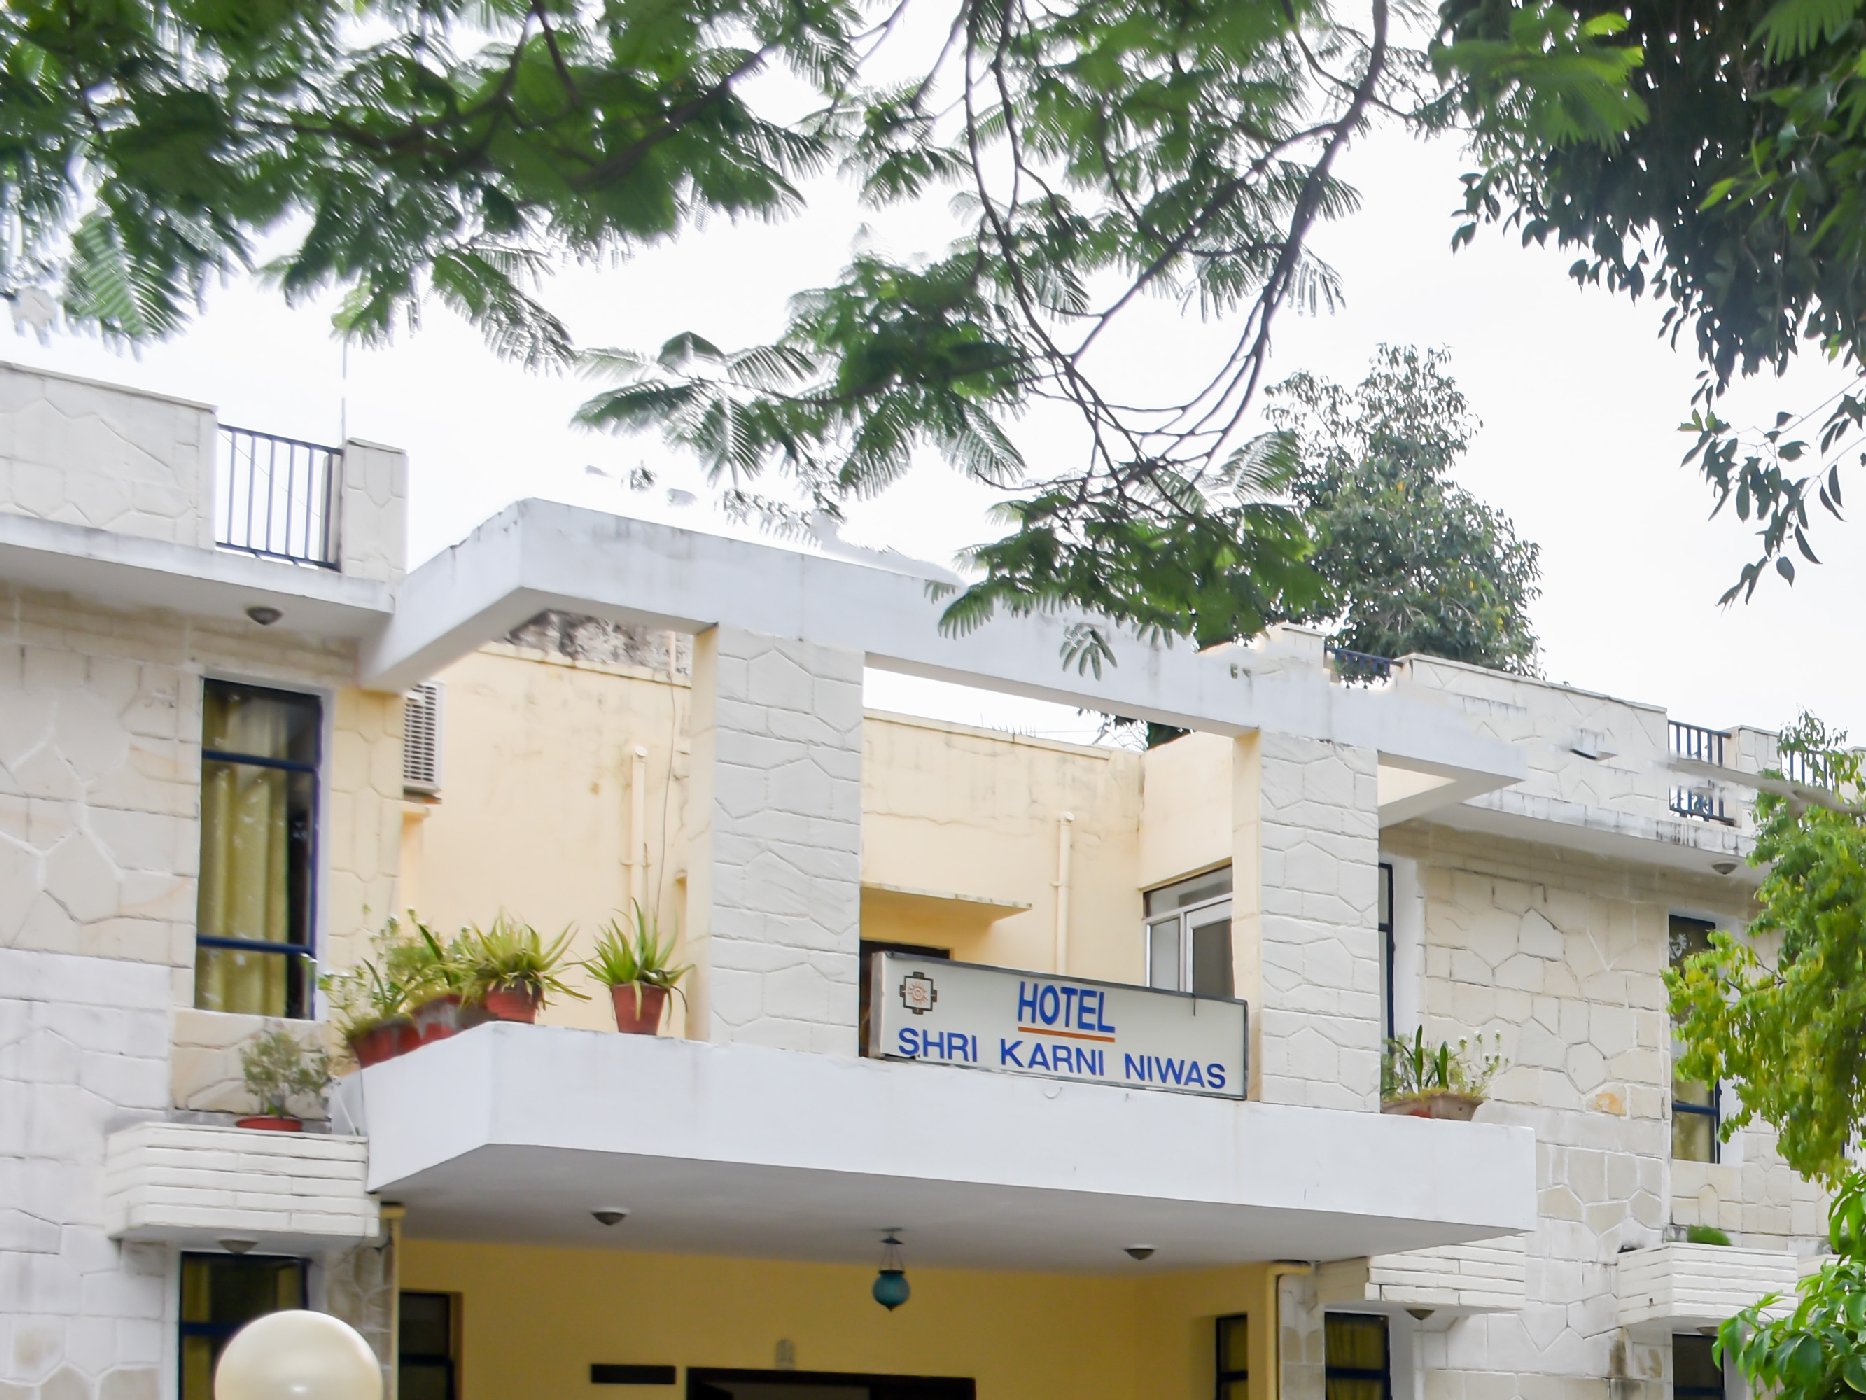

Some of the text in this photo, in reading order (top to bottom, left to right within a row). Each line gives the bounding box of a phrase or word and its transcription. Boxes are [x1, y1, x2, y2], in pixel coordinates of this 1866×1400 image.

[1017, 981, 1116, 1034] HOTEL
[898, 1027, 1226, 1089] SHRI KARNI NIWAS
